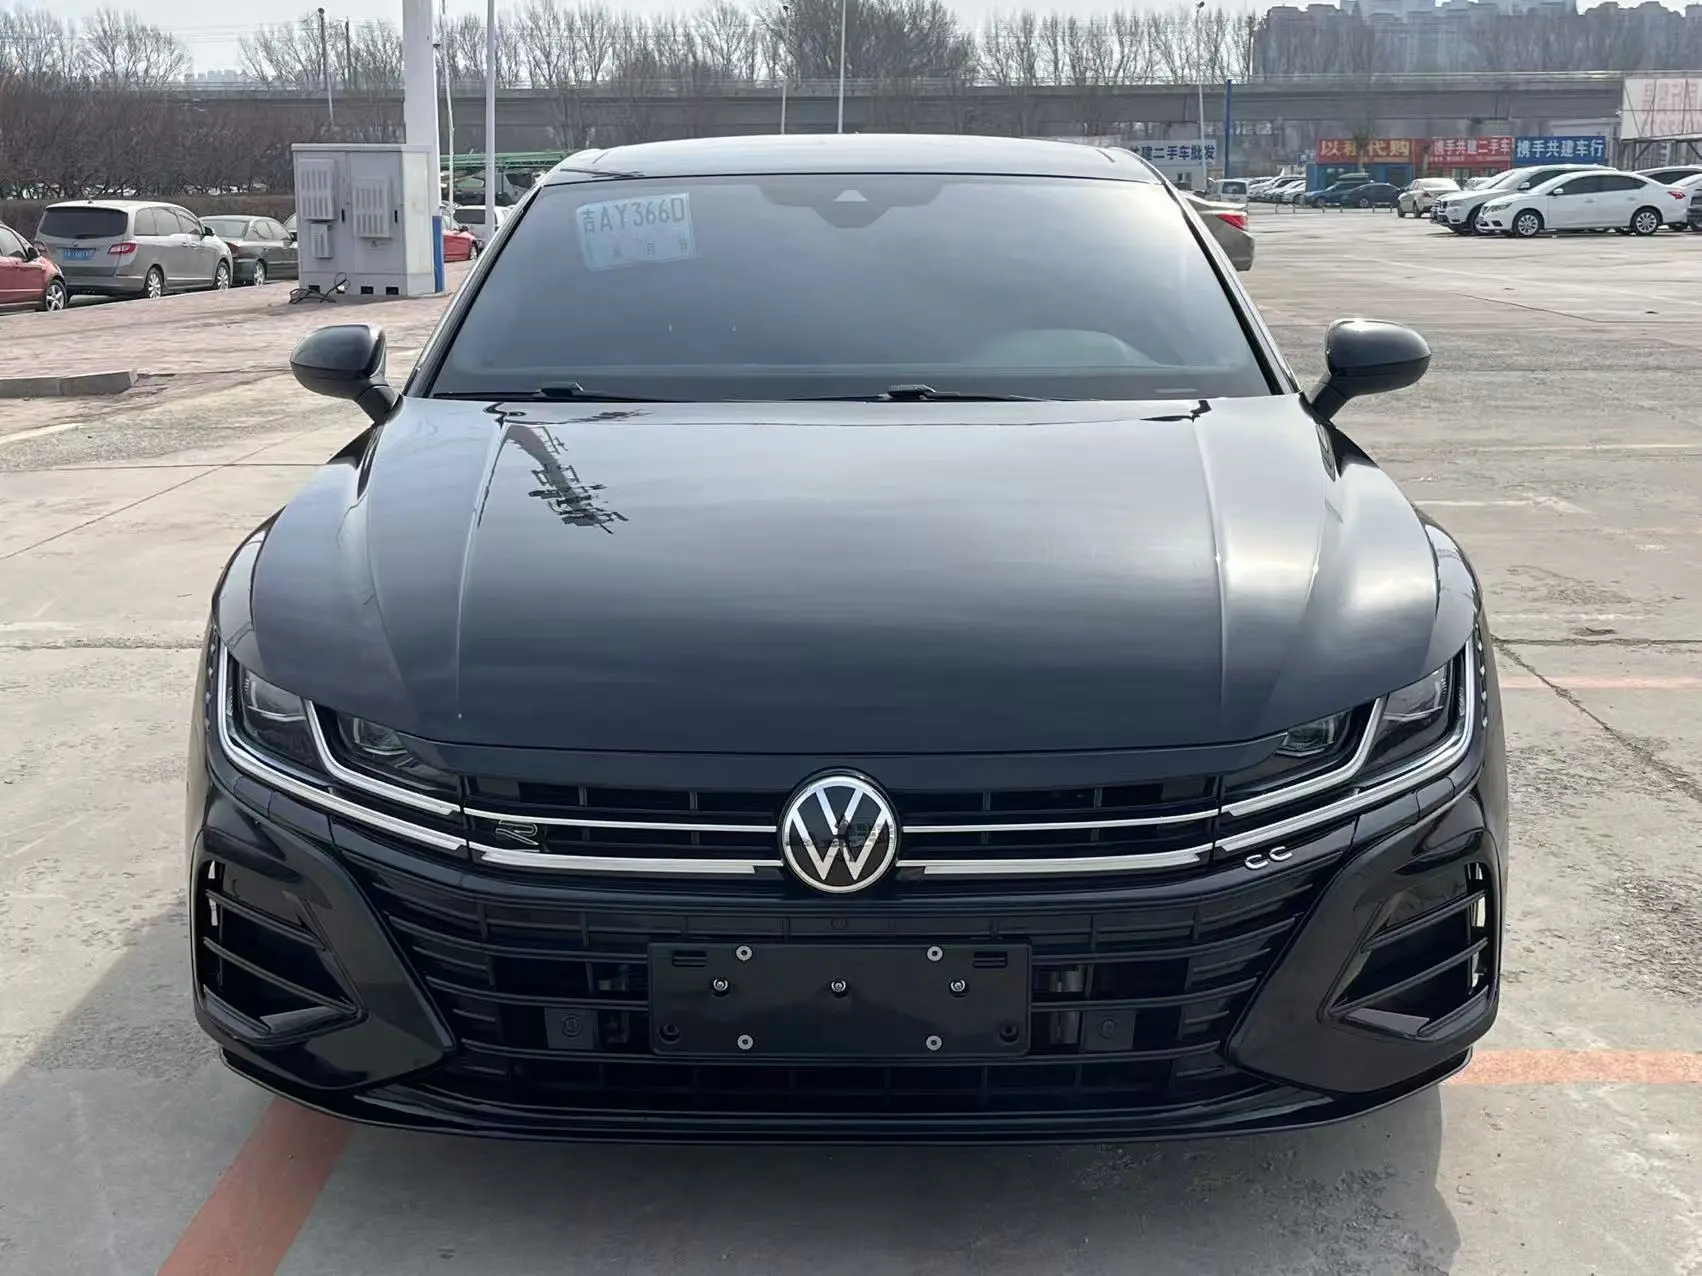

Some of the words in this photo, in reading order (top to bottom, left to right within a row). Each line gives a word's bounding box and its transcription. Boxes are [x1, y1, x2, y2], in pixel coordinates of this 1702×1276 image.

[1517, 139, 1604, 158] 携手共建车行
[784, 776, 896, 893] VW
[1245, 846, 1293, 869] CC
